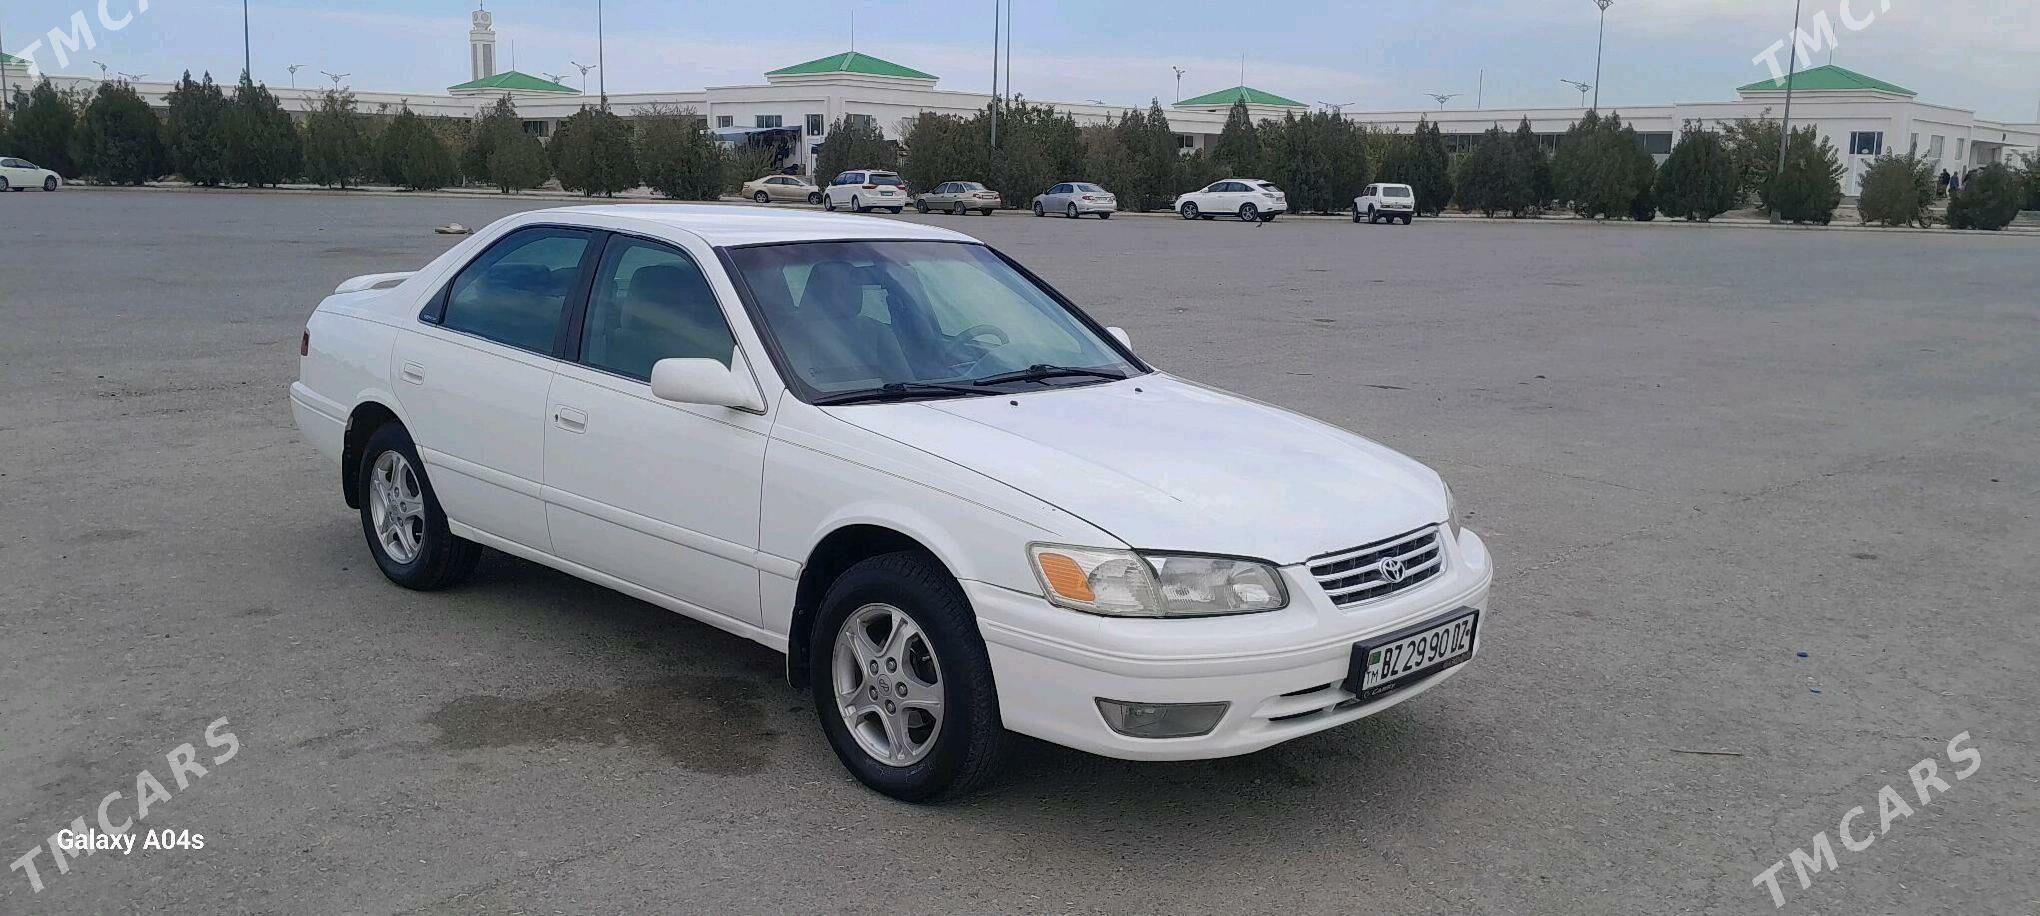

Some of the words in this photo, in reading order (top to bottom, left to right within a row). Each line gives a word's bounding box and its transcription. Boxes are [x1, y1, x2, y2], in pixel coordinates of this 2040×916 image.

[1381, 644, 1403, 679] BZ
[1402, 637, 1426, 672] 29
[1428, 629, 1449, 662] 90
[1451, 620, 1468, 653] DZ
[1366, 669, 1379, 686] TM
